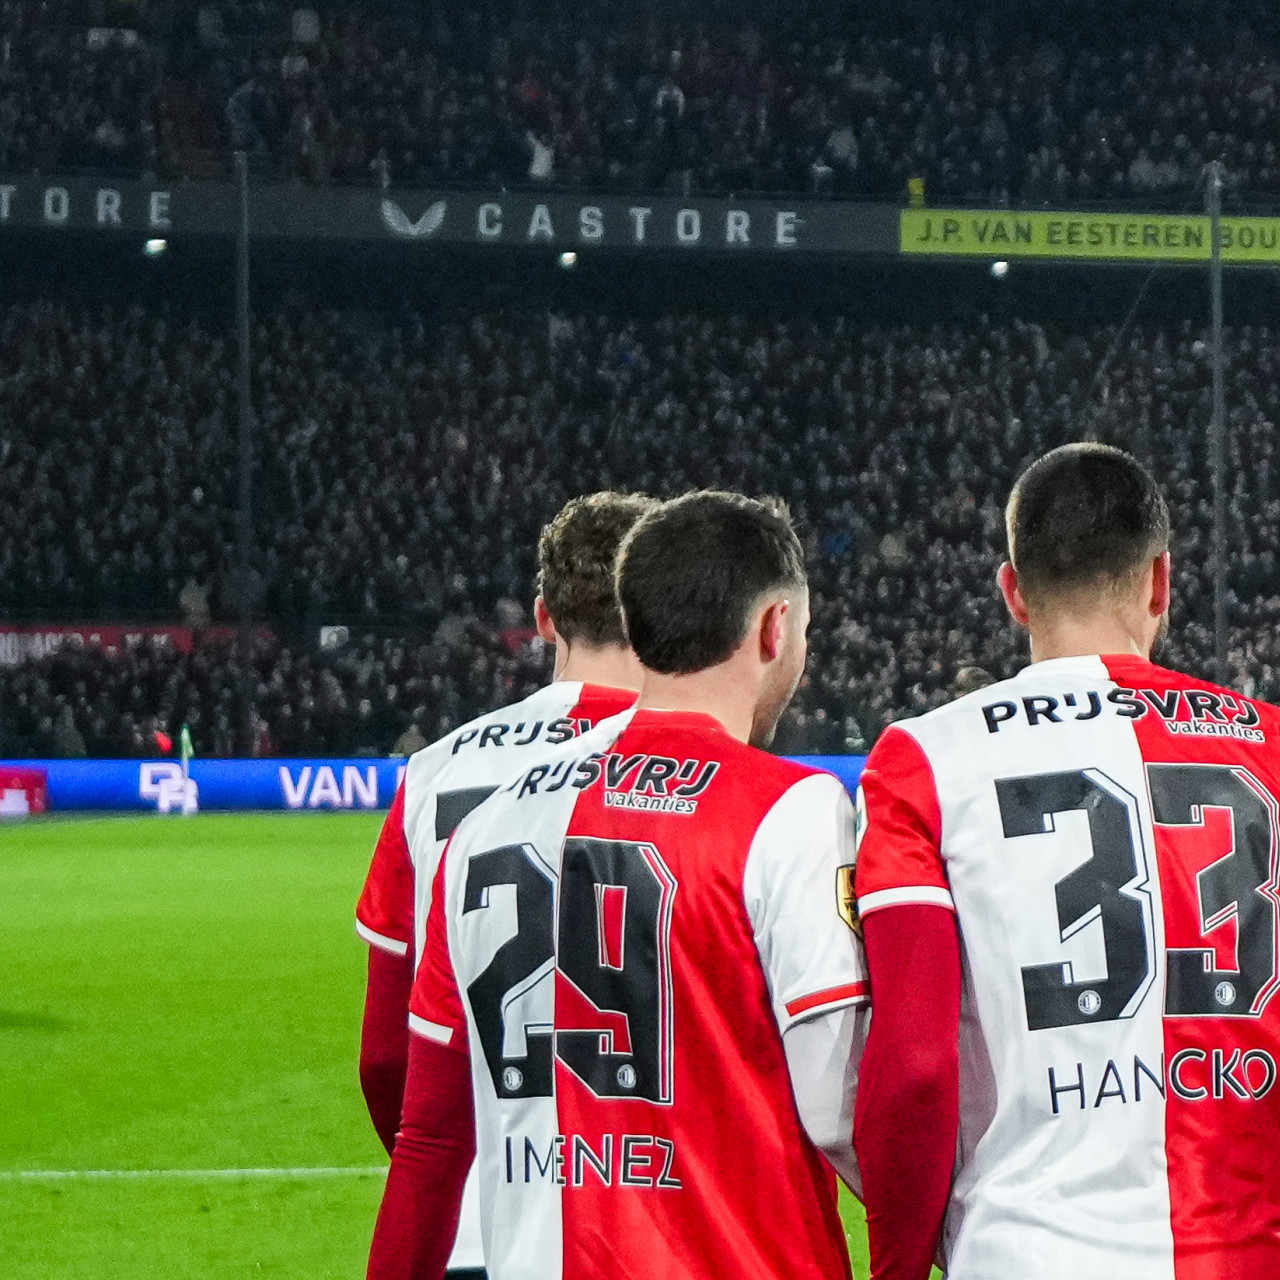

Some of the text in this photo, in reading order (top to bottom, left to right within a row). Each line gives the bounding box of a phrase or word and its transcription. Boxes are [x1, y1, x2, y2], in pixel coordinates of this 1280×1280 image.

[478, 202, 797, 245] CASTORE
[974, 219, 1033, 245] VAN
[1046, 221, 1204, 248] EESTEREN
[452, 717, 592, 756] PRIJS
[1167, 719, 1266, 743] vakanties
[279, 765, 379, 809] VAN
[505, 752, 720, 800] RIJSVRIJ
[605, 790, 698, 814] vakanties
[462, 836, 678, 1105] 29
[1048, 1047, 1278, 1115] HANCKO
